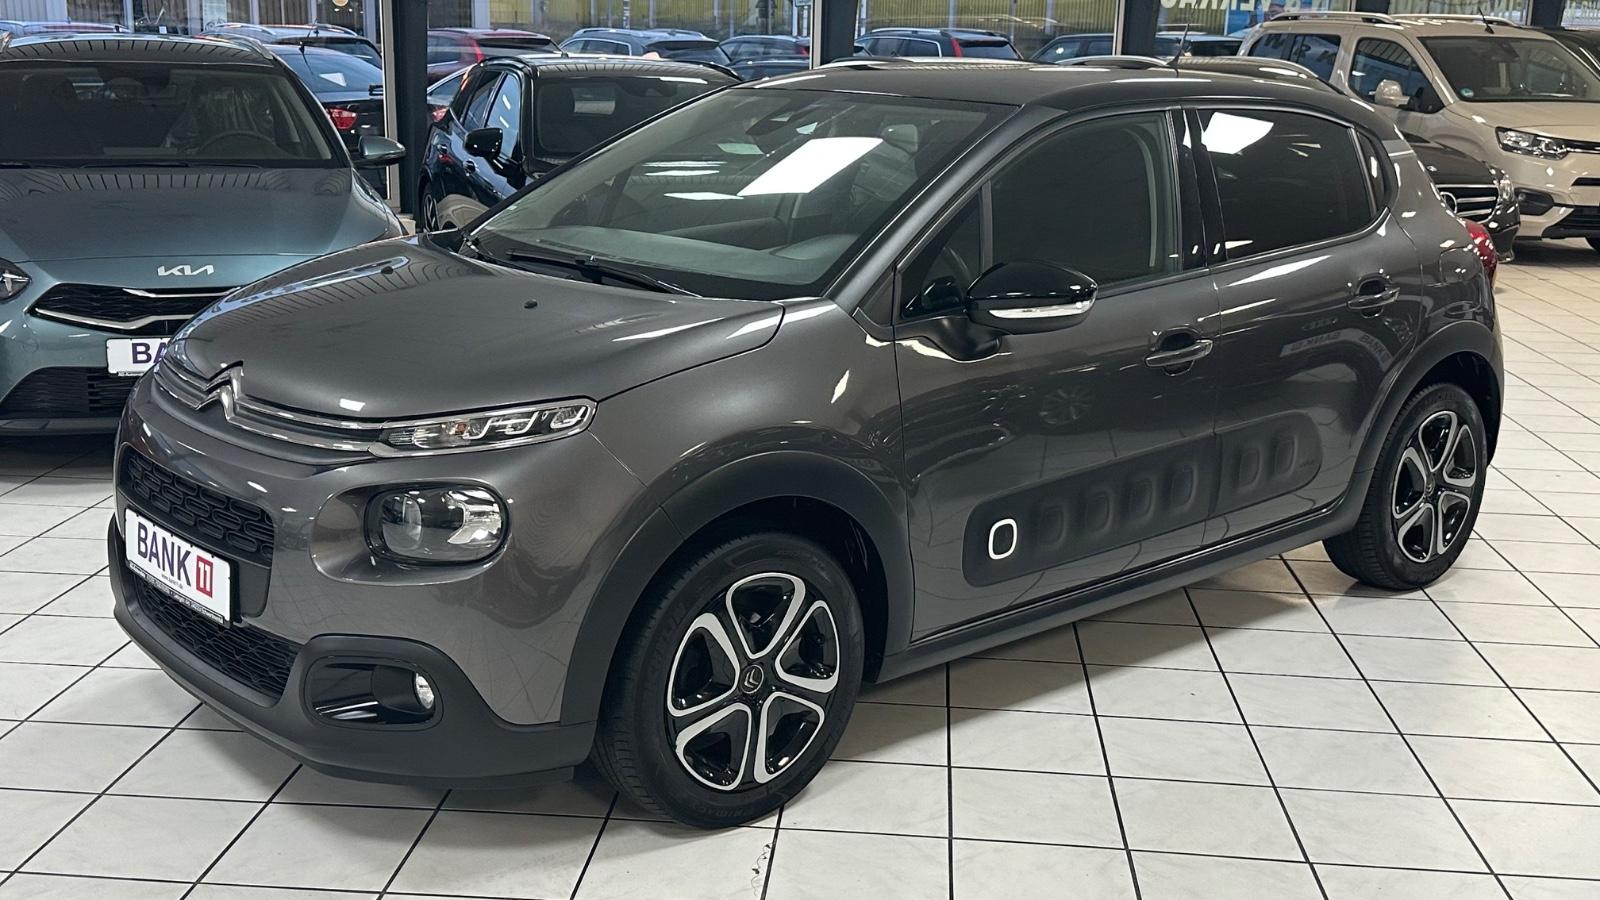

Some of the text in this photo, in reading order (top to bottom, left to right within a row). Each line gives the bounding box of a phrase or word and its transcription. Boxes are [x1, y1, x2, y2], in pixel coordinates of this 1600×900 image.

[158, 264, 214, 275] KIA
[138, 521, 191, 587] BANK
[198, 559, 212, 594] 11
